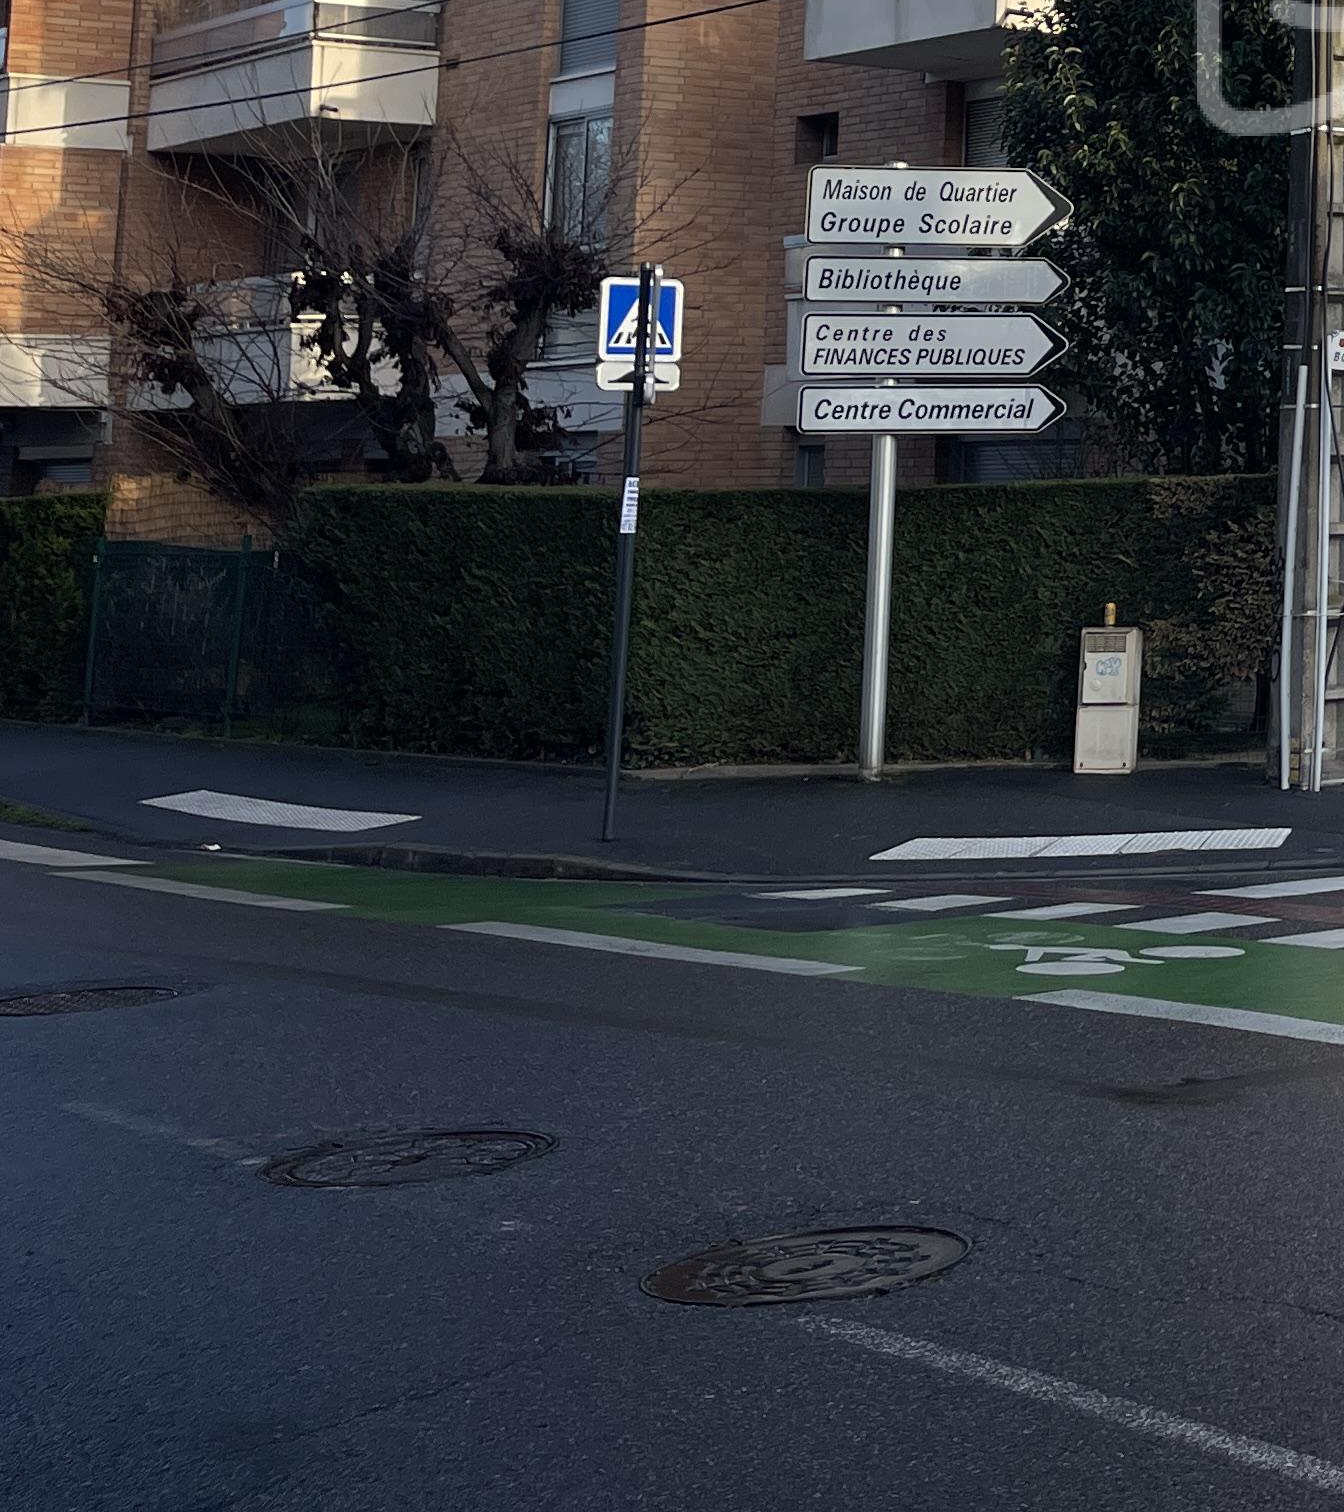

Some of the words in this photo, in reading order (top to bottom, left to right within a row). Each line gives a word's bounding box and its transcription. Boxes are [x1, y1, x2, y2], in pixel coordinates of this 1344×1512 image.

[822, 179, 892, 201] Maison
[904, 181, 927, 202] de
[939, 181, 1017, 204] Quartier
[820, 212, 905, 238] Groupe
[918, 213, 1013, 236] Scolaire
[819, 268, 962, 296] Bibliothèque
[815, 325, 894, 342] Centre
[908, 325, 947, 342] des
[812, 348, 911, 366] FINANCES
[915, 348, 1026, 366] PUBLIQUES
[814, 399, 892, 420] Centre
[898, 397, 1035, 420] Commercial
